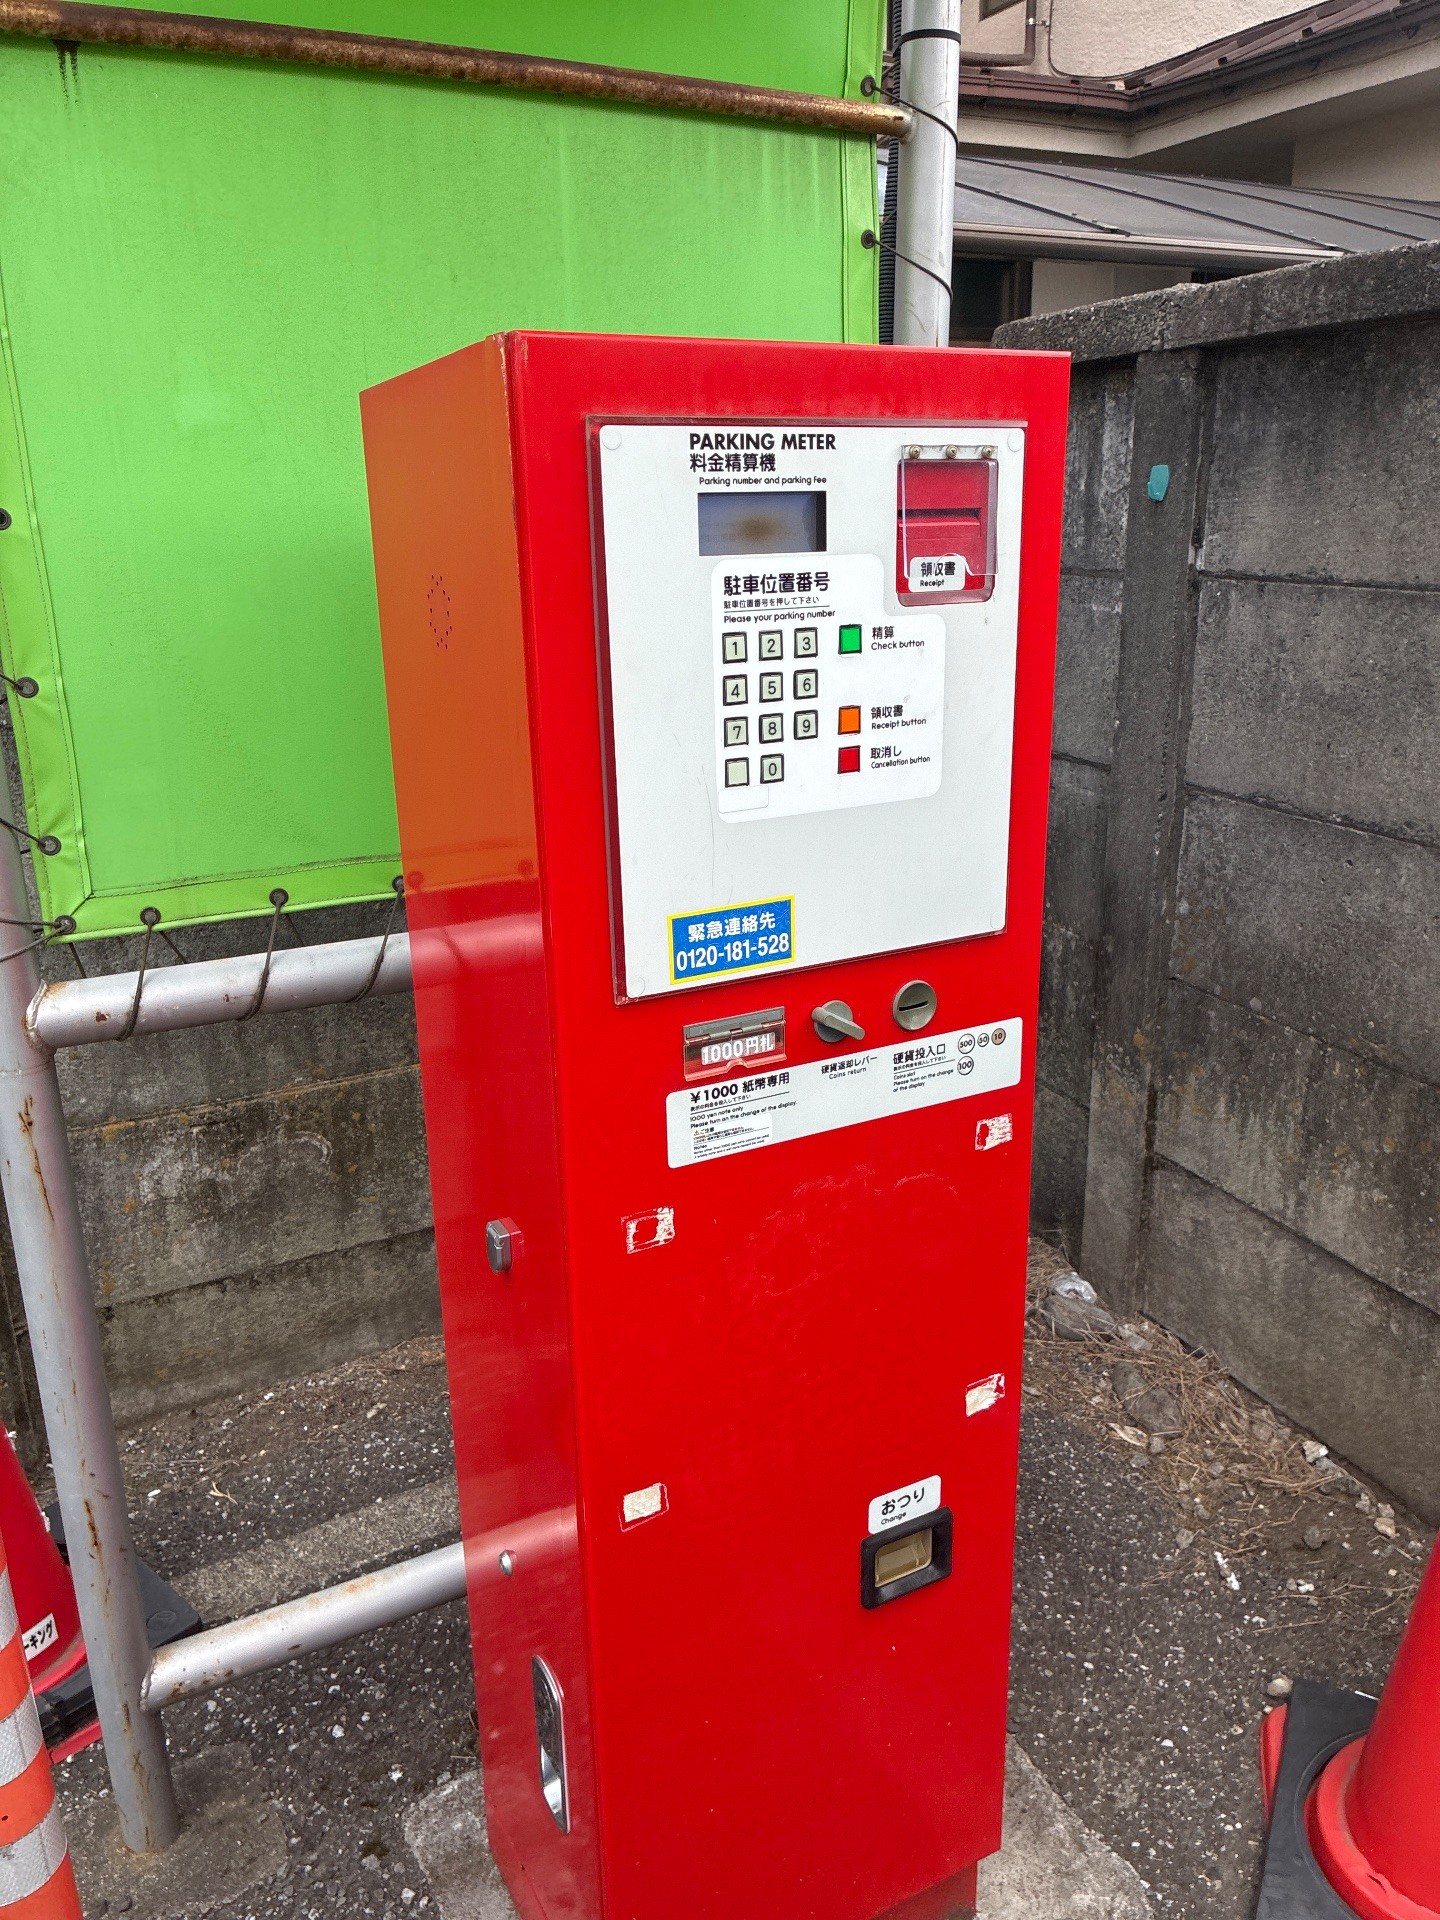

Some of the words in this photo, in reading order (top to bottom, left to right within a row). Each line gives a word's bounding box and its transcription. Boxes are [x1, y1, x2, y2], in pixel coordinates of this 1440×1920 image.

[690, 432, 775, 450] PARKING
[781, 433, 836, 450] METER
[690, 453, 776, 472] 料金精算機
[699, 476, 730, 487] Parking
[732, 476, 762, 484] number
[764, 476, 780, 484] and
[782, 476, 812, 486] parking
[920, 562, 956, 577] 領収書
[724, 572, 830, 596] 駐車位置番号
[920, 579, 945, 588] Receipt
[724, 596, 820, 609] 駐車位置番号を押して下さい
[724, 615, 752, 623] Please
[754, 614, 772, 624] your
[774, 611, 805, 622] parking
[806, 610, 836, 618] number
[871, 626, 894, 640] 精算
[732, 641, 738, 656] 1
[767, 638, 776, 652] 2
[802, 636, 811, 650] 3
[870, 641, 898, 650] Check
[898, 640, 925, 648] button
[730, 684, 740, 698] 4
[768, 680, 776, 694] 5
[802, 678, 811, 692] 6
[870, 704, 903, 720] 領収書
[732, 726, 742, 740] 7
[768, 722, 776, 736] 8
[802, 719, 811, 733] 9
[871, 720, 900, 730] Receipt
[901, 718, 926, 727] button
[870, 746, 902, 759] 取消し
[768, 762, 777, 776] 0
[870, 758, 908, 769] Cancellation
[910, 756, 930, 764] button
[688, 912, 776, 942] 緊急連絡先
[676, 932, 790, 972] 0120-181-528
[959, 1039, 973, 1048] 500
[979, 1036, 988, 1044] 50
[994, 1032, 1002, 1040] 10
[702, 1034, 774, 1065] 1000円札
[893, 1043, 946, 1064] 硬貨投入口
[822, 1056, 878, 1074] 硬貨返却レバー
[958, 1060, 972, 1070] 100
[829, 1071, 846, 1080] Coins
[848, 1067, 867, 1075] return
[928, 1072, 936, 1080] the
[936, 1068, 954, 1078] change
[690, 1084, 738, 1104] ¥1000
[742, 1072, 790, 1094] 紙幣専用
[690, 1113, 706, 1122] 1000
[706, 1112, 717, 1120] yen
[732, 1106, 744, 1115] only
[690, 1120, 708, 1129] Please
[709, 1118, 720, 1126] turn
[730, 1112, 740, 1120] the
[740, 1109, 760, 1120] change
[881, 1487, 925, 1516] おつり
[880, 1512, 907, 1525] Change
